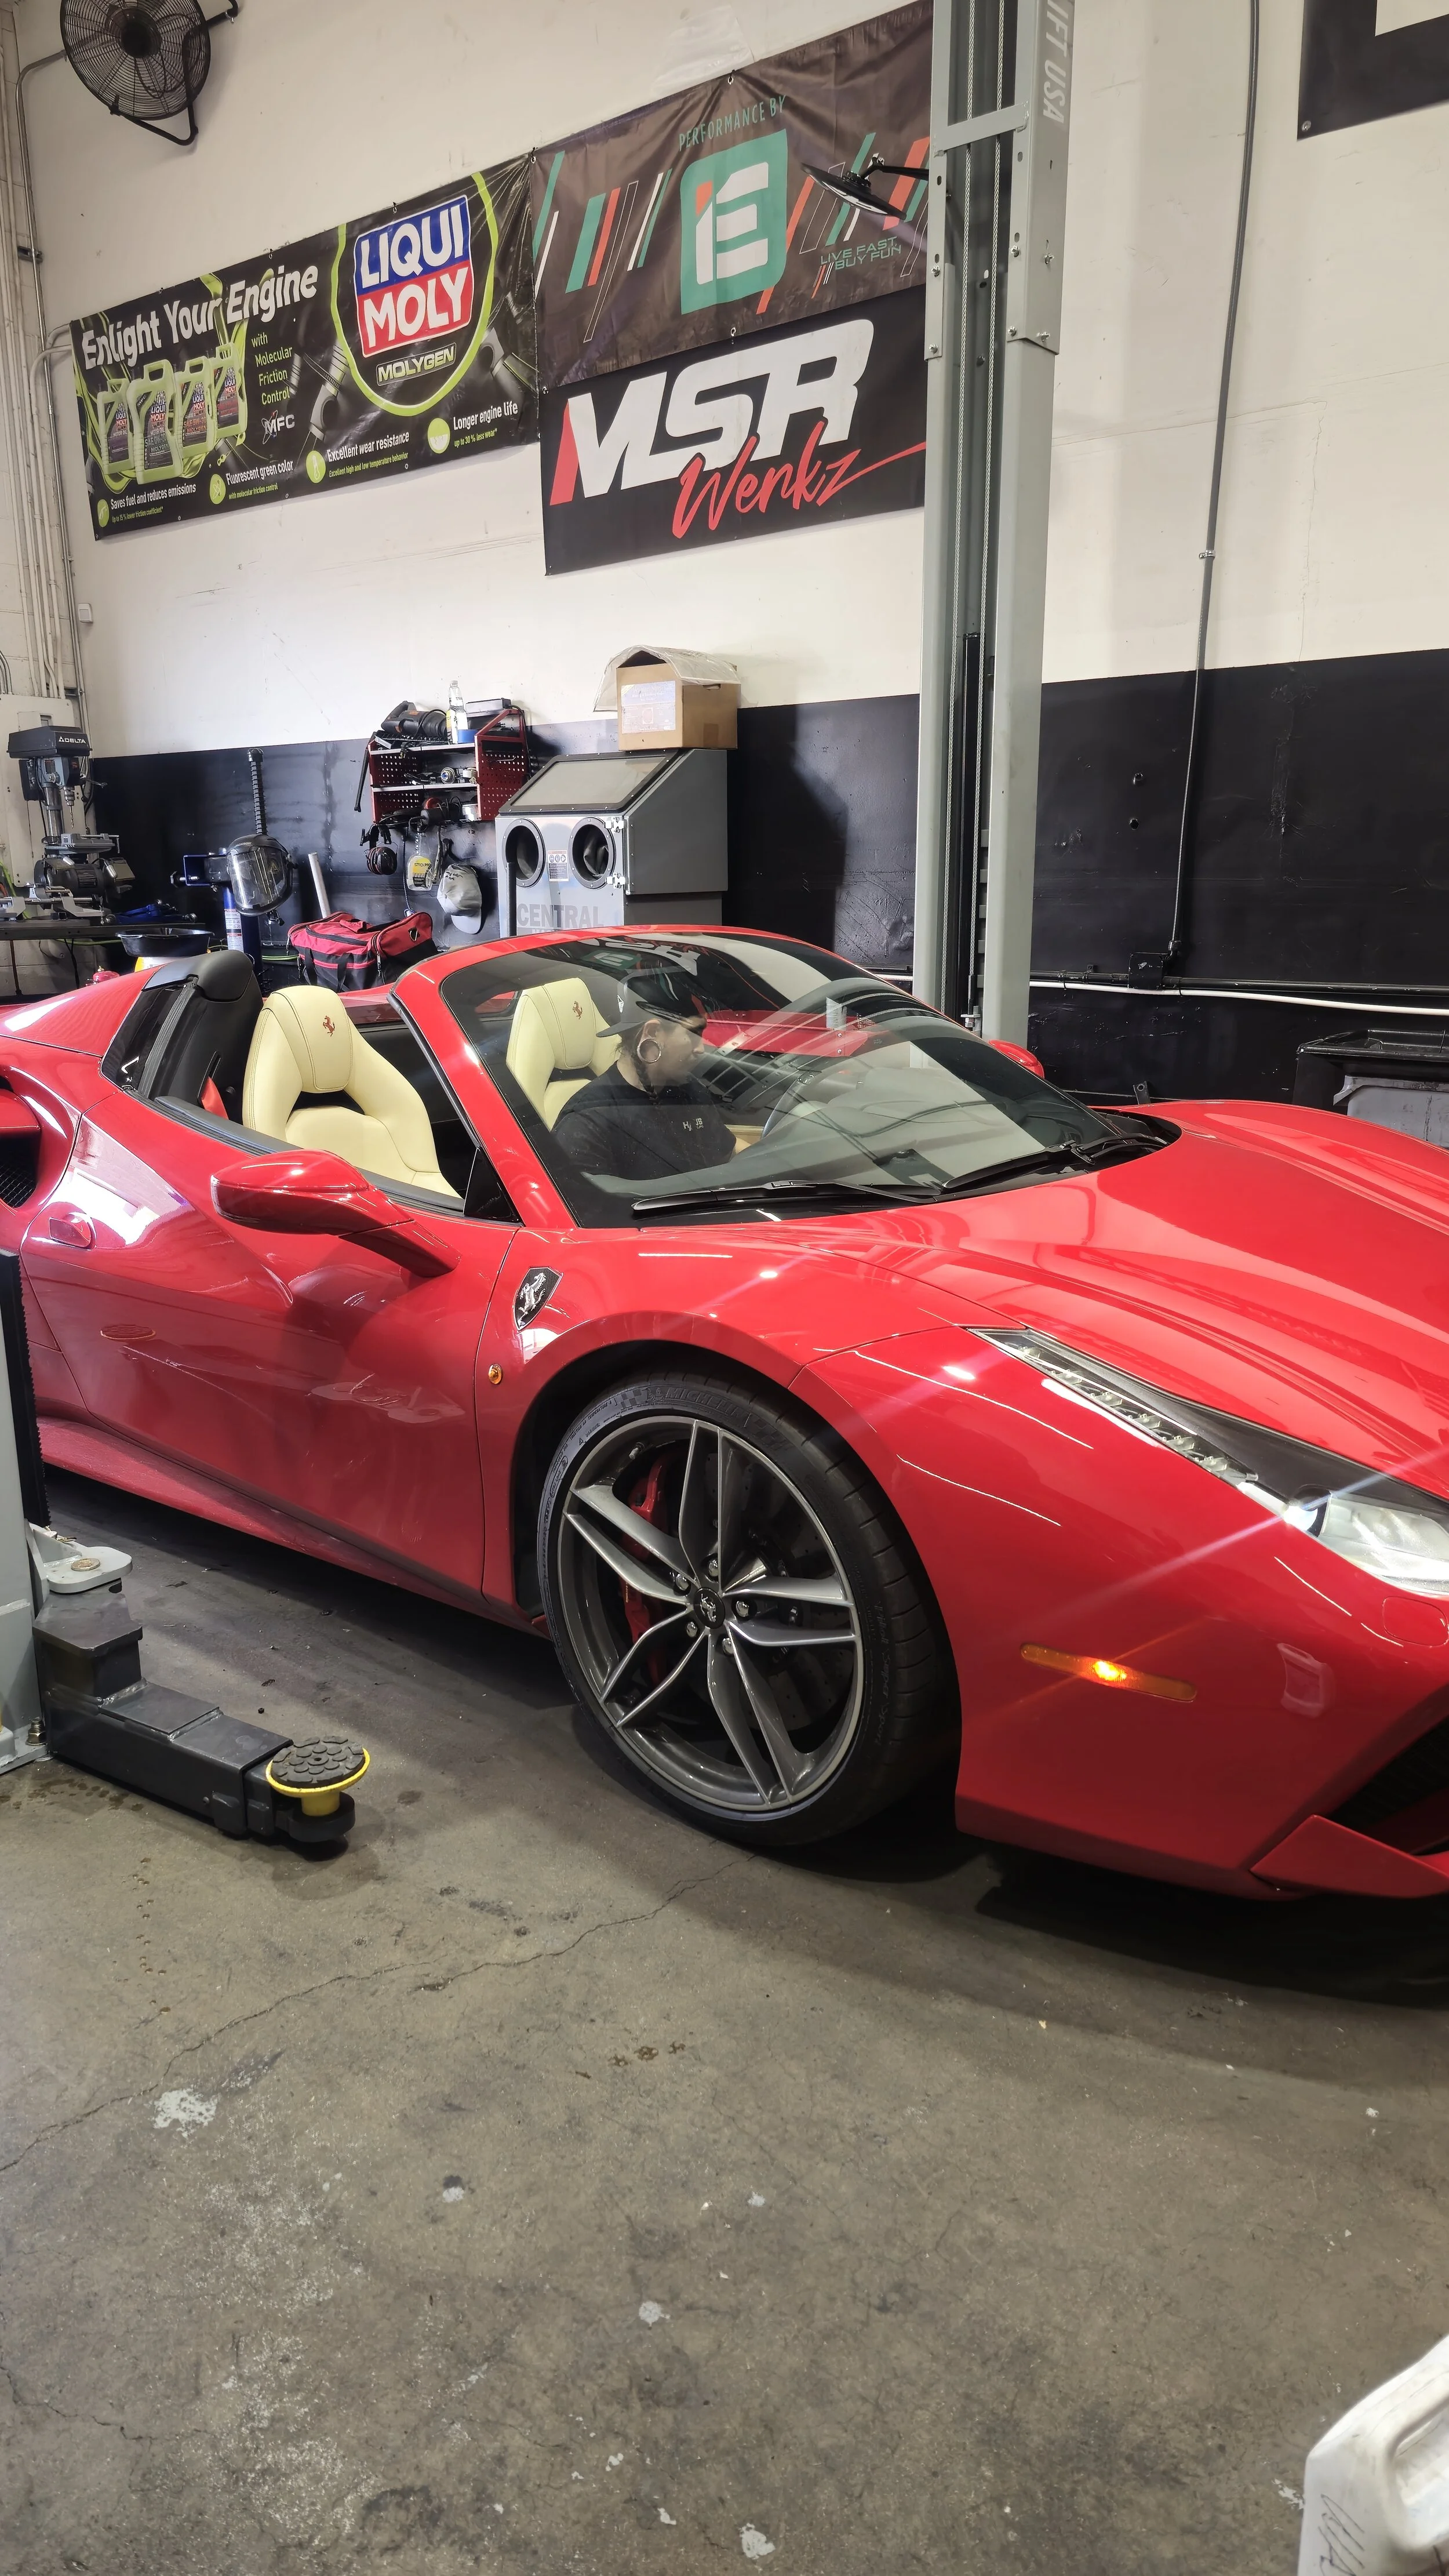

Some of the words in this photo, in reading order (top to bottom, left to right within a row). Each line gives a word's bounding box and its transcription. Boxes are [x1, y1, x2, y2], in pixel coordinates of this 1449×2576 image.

[1046, 0, 1068, 57] IFT
[1043, 60, 1066, 123] USA
[679, 101, 765, 151] PERFORMANCE
[770, 95, 786, 117] BY
[361, 205, 464, 288] LIQUI
[821, 249, 853, 264] LIVE
[835, 254, 867, 270] BUY
[871, 245, 901, 261] FUN
[82, 311, 162, 370] Enlight
[163, 297, 223, 344] Your
[227, 266, 318, 325] Engine
[363, 267, 468, 348] MOLY
[252, 332, 268, 347] with
[255, 347, 292, 367] Molecular
[378, 346, 454, 383] MOLYGEN
[225, 386, 236, 394] MOLY
[259, 369, 287, 386] Friction
[193, 395, 204, 404] LIQUI
[194, 401, 205, 410] MOLY
[261, 386, 290, 405] Control
[151, 405, 165, 414] LIQUI
[151, 413, 165, 422] MOLY
[453, 413, 478, 430] Longer
[479, 406, 502, 424] engine
[504, 401, 518, 416] life
[549, 319, 874, 506] MSR
[264, 415, 295, 434] MFC
[327, 445, 358, 462] Excellent
[359, 441, 375, 455] wear
[376, 431, 409, 450] resistance
[226, 467, 259, 485] Fluorescent
[260, 464, 277, 480] green
[278, 459, 293, 473] color
[329, 467, 345, 477] Excellent
[346, 466, 354, 474] high
[369, 458, 392, 468] temperature
[392, 452, 408, 463] behavior
[111, 498, 125, 510] Saves
[126, 494, 136, 506] fuel
[137, 492, 147, 504] and
[147, 489, 168, 502] reduces
[168, 483, 196, 497] emissions
[236, 489, 253, 498] molecular
[253, 486, 265, 495] friction
[265, 483, 278, 492] control
[517, 903, 604, 928] CENTRAL
